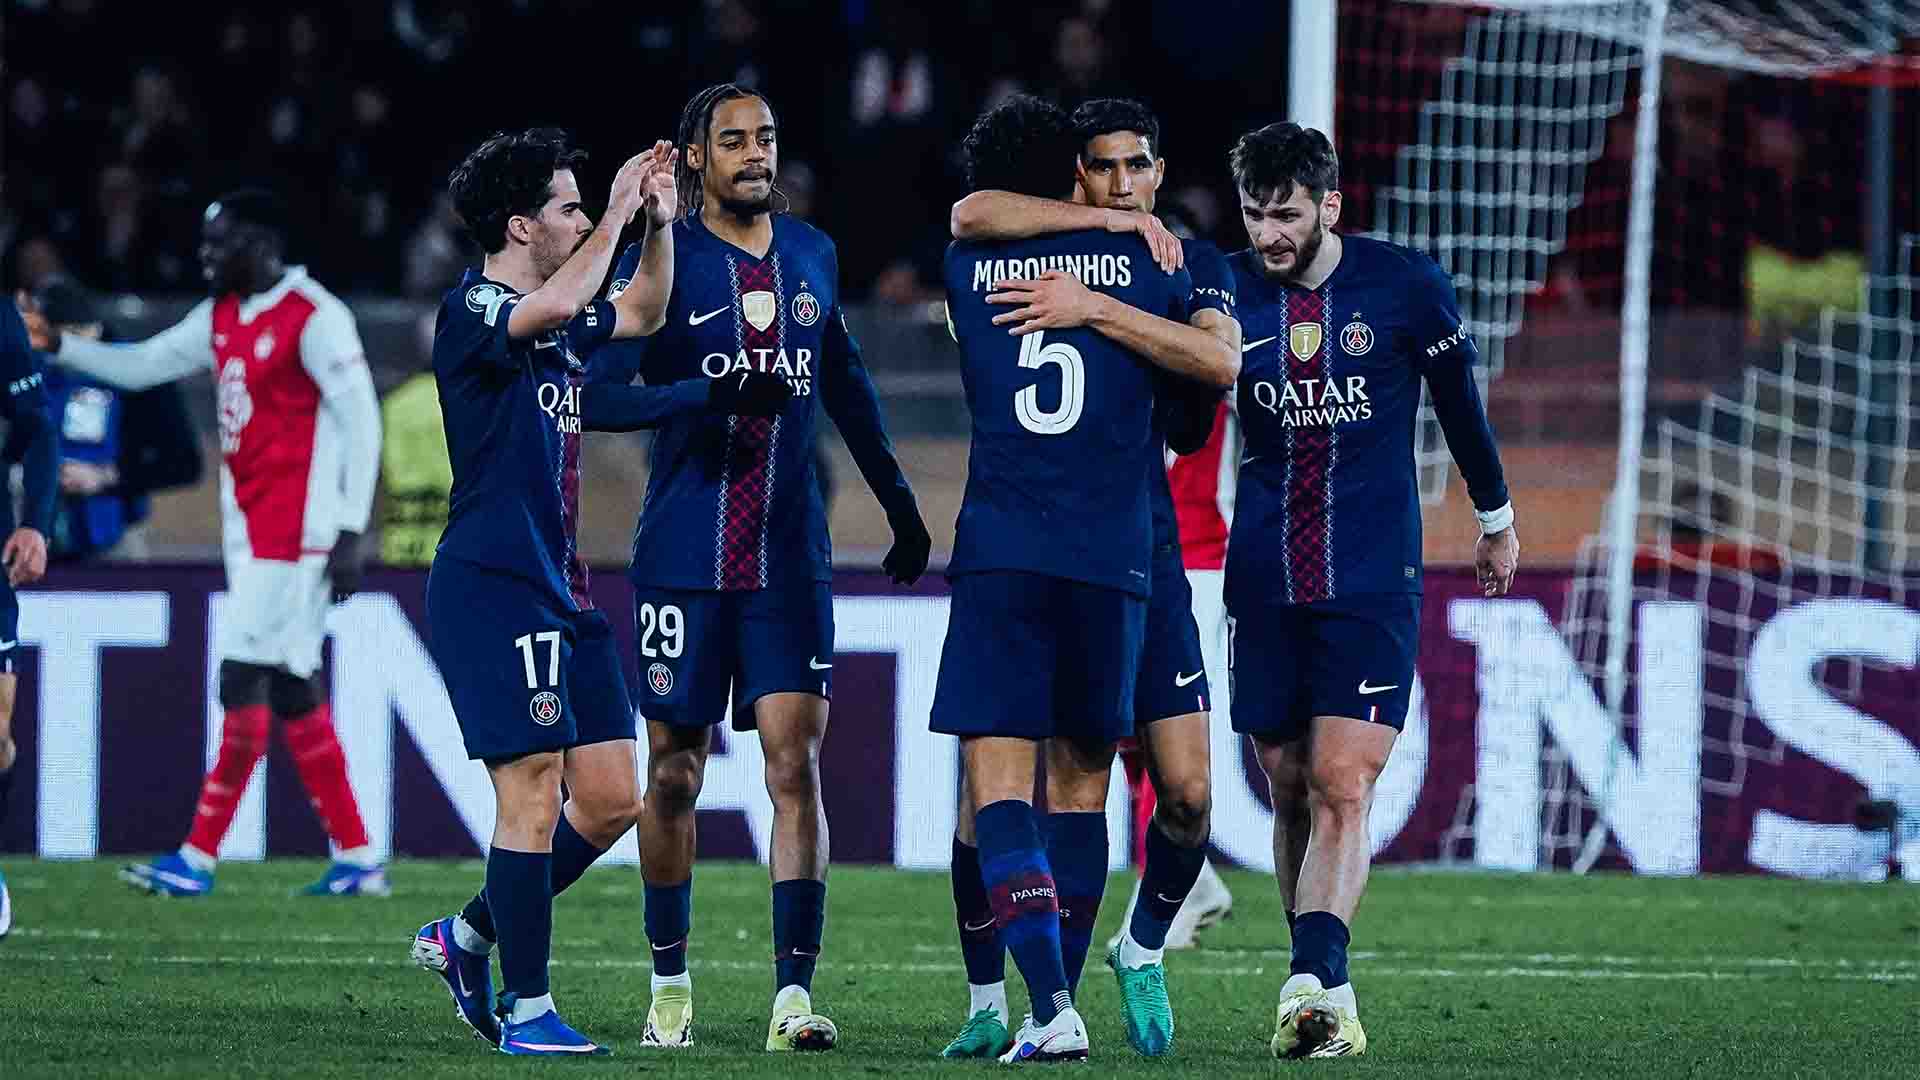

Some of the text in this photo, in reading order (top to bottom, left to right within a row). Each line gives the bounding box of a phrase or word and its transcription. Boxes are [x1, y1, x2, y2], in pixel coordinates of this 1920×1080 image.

[1014, 330, 1085, 434] 5
[1253, 375, 1369, 415] QATAR
[1281, 401, 1372, 427] AIRWAYS
[640, 602, 685, 658] 29
[515, 631, 560, 689] 17
[1011, 887, 1056, 903] PARIS
